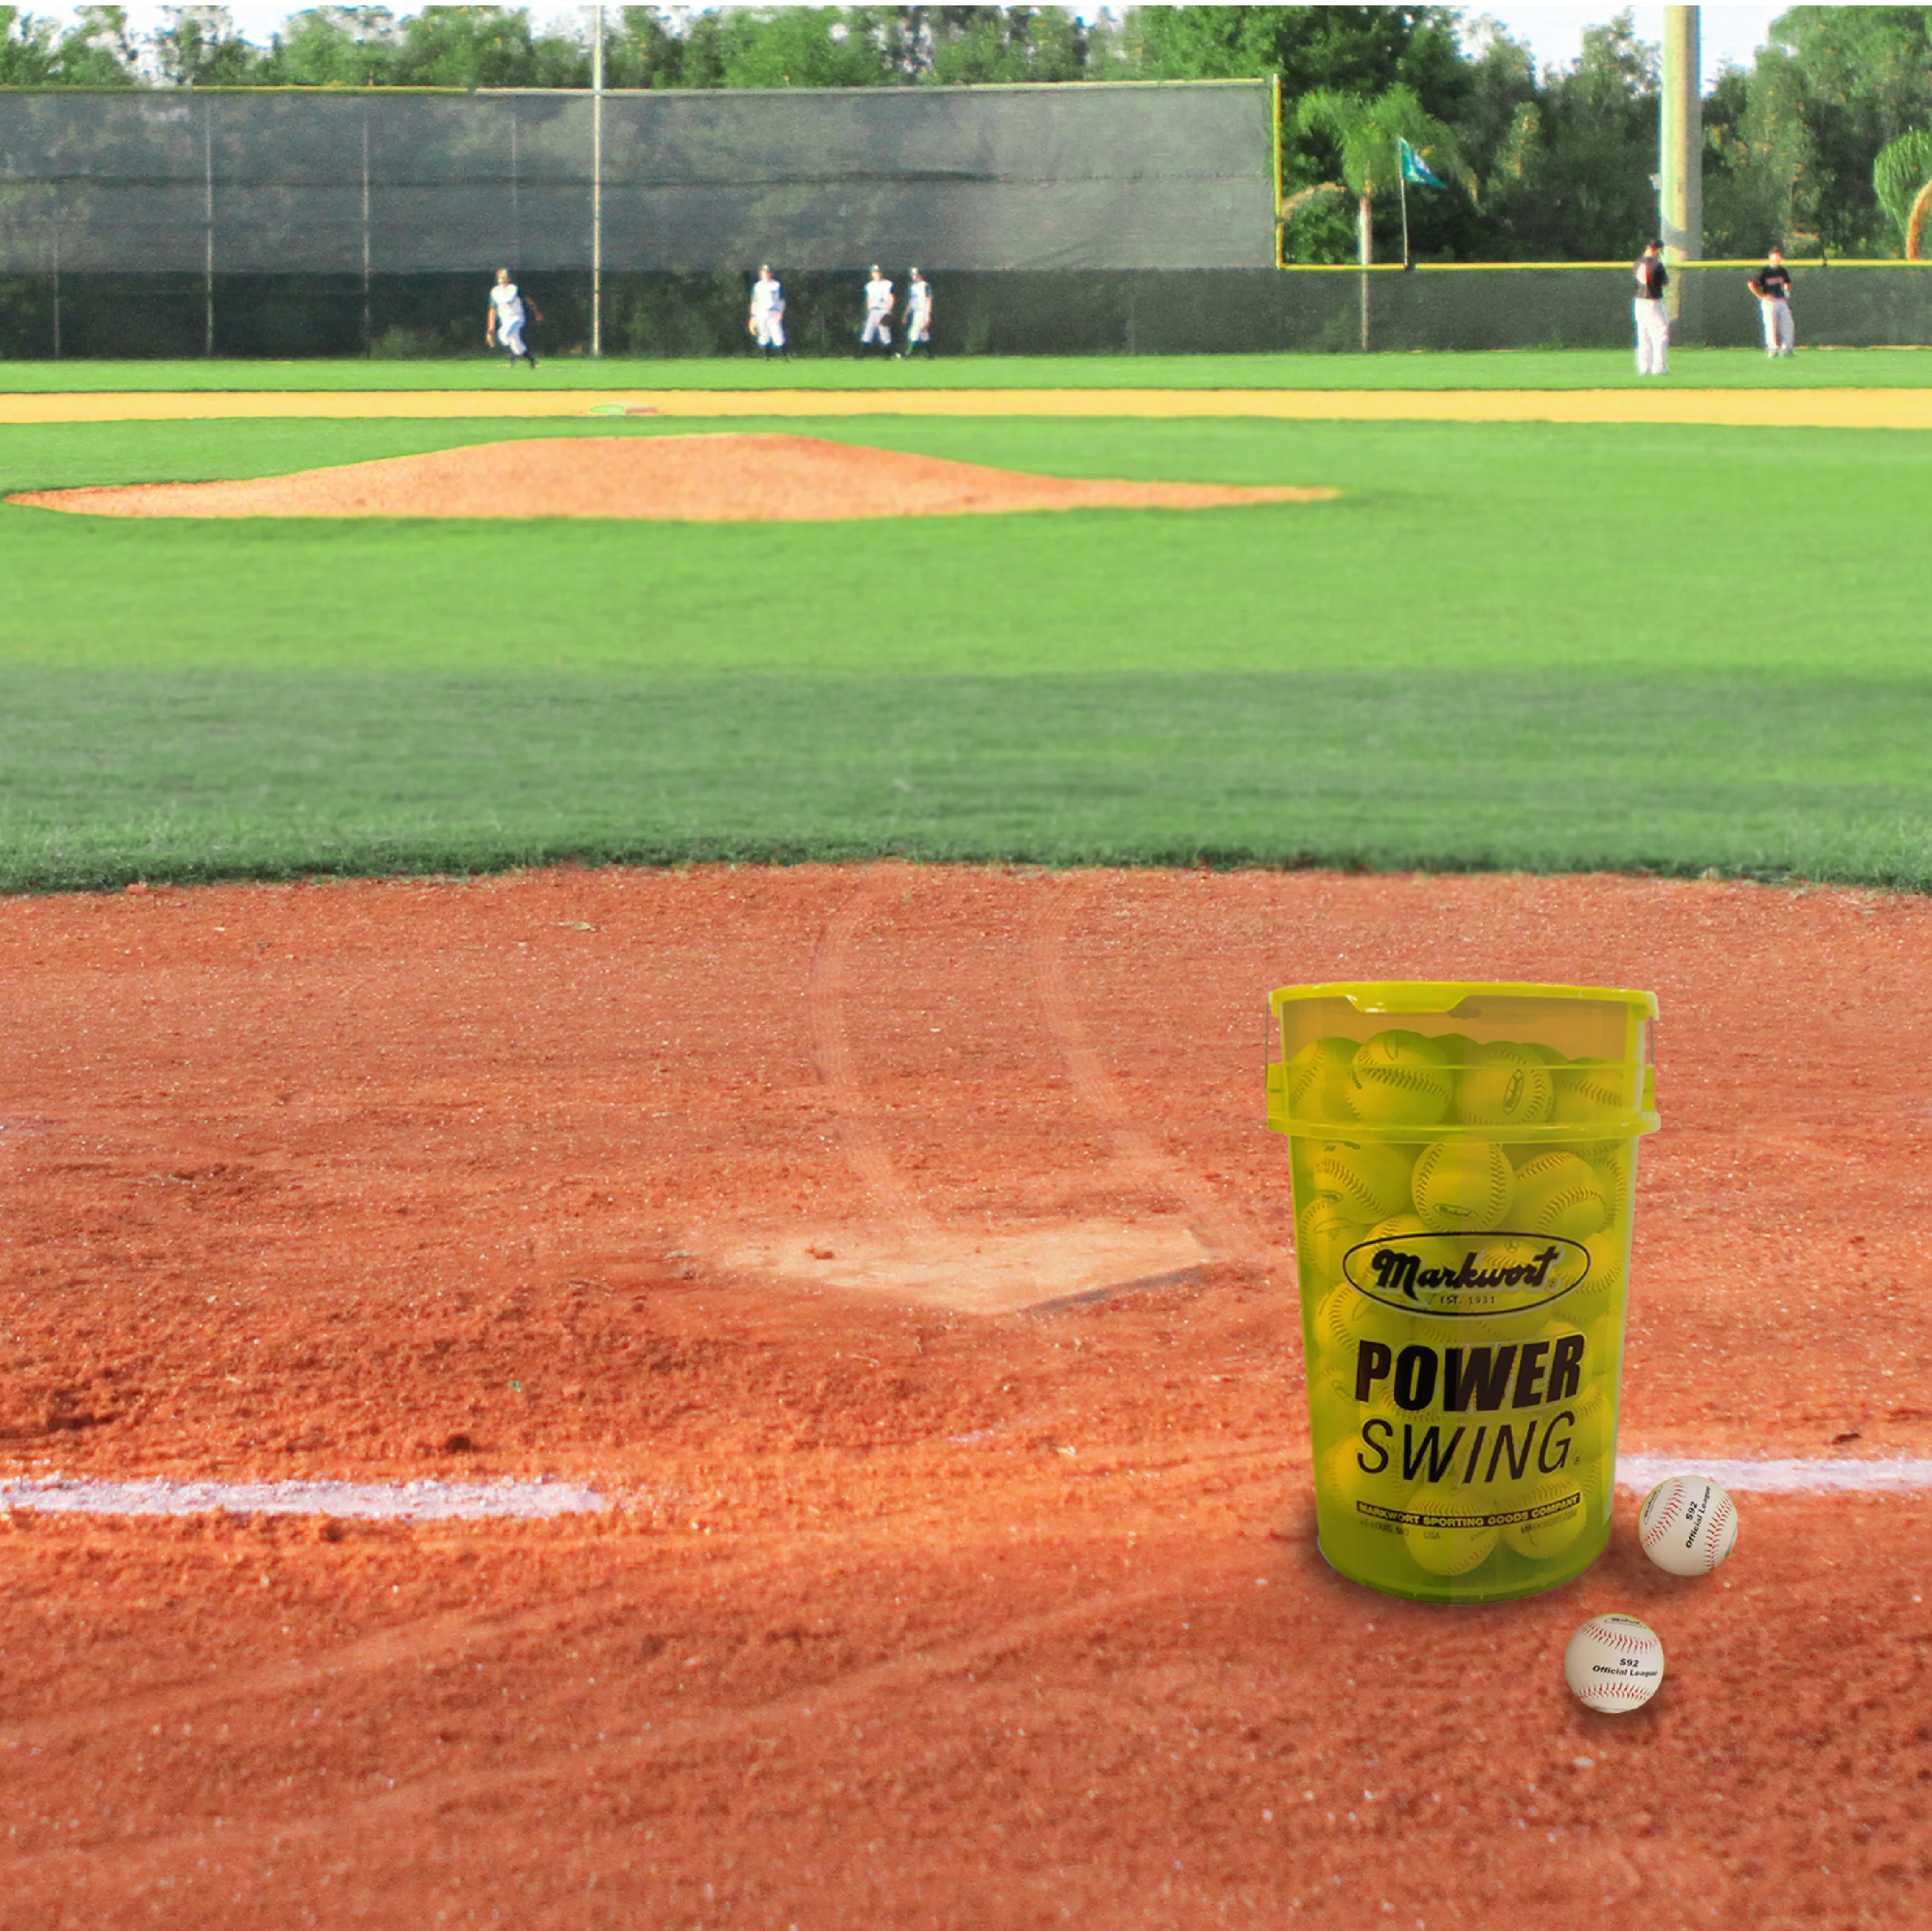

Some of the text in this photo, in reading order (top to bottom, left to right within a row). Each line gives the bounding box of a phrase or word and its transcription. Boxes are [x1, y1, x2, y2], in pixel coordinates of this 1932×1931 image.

[1372, 1246, 1561, 1301] Markwort
[1468, 1296, 1496, 1304] 1931
[1355, 1334, 1585, 1412] POWER
[1356, 1410, 1576, 1483] SWING
[1359, 1495, 1579, 1528] MARKWORT SPORTING GOODS COMPANY
[1686, 1485, 1711, 1548] Official League
[1592, 1665, 1627, 1676] Official
